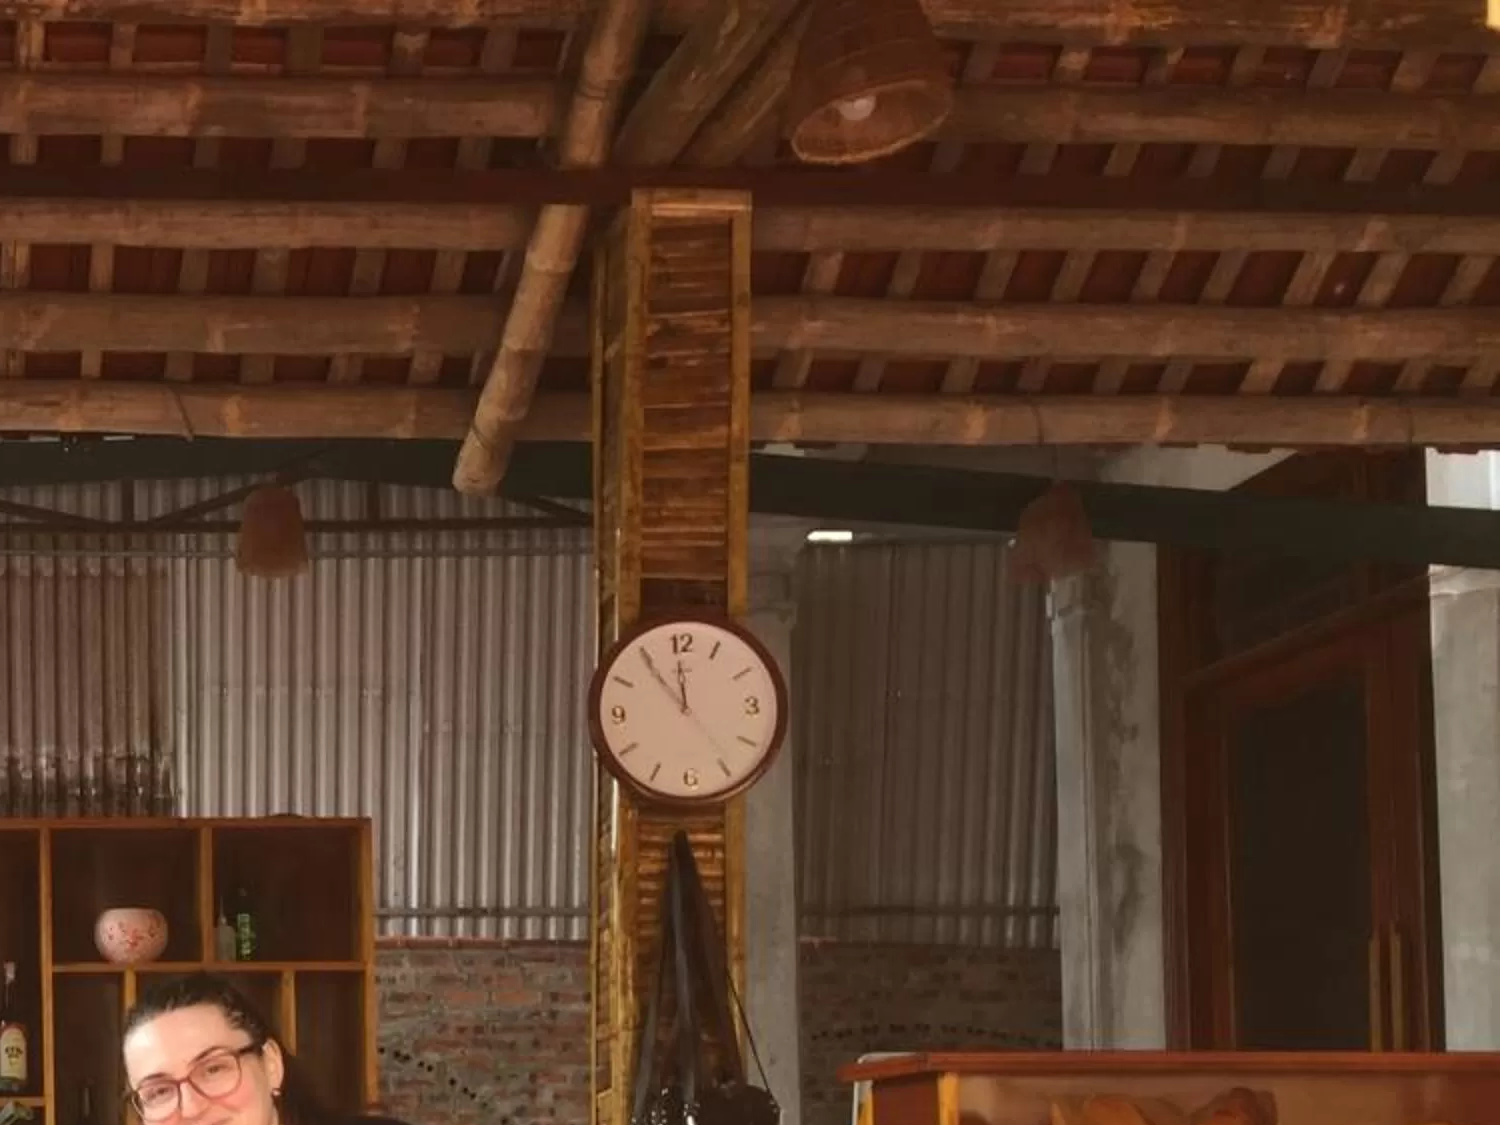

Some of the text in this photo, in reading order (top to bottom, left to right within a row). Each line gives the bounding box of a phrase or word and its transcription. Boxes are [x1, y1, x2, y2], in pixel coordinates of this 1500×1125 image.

[670, 633, 694, 654] 12
[611, 705, 626, 724] 9
[744, 696, 761, 716] 3
[683, 768, 699, 787] 6
